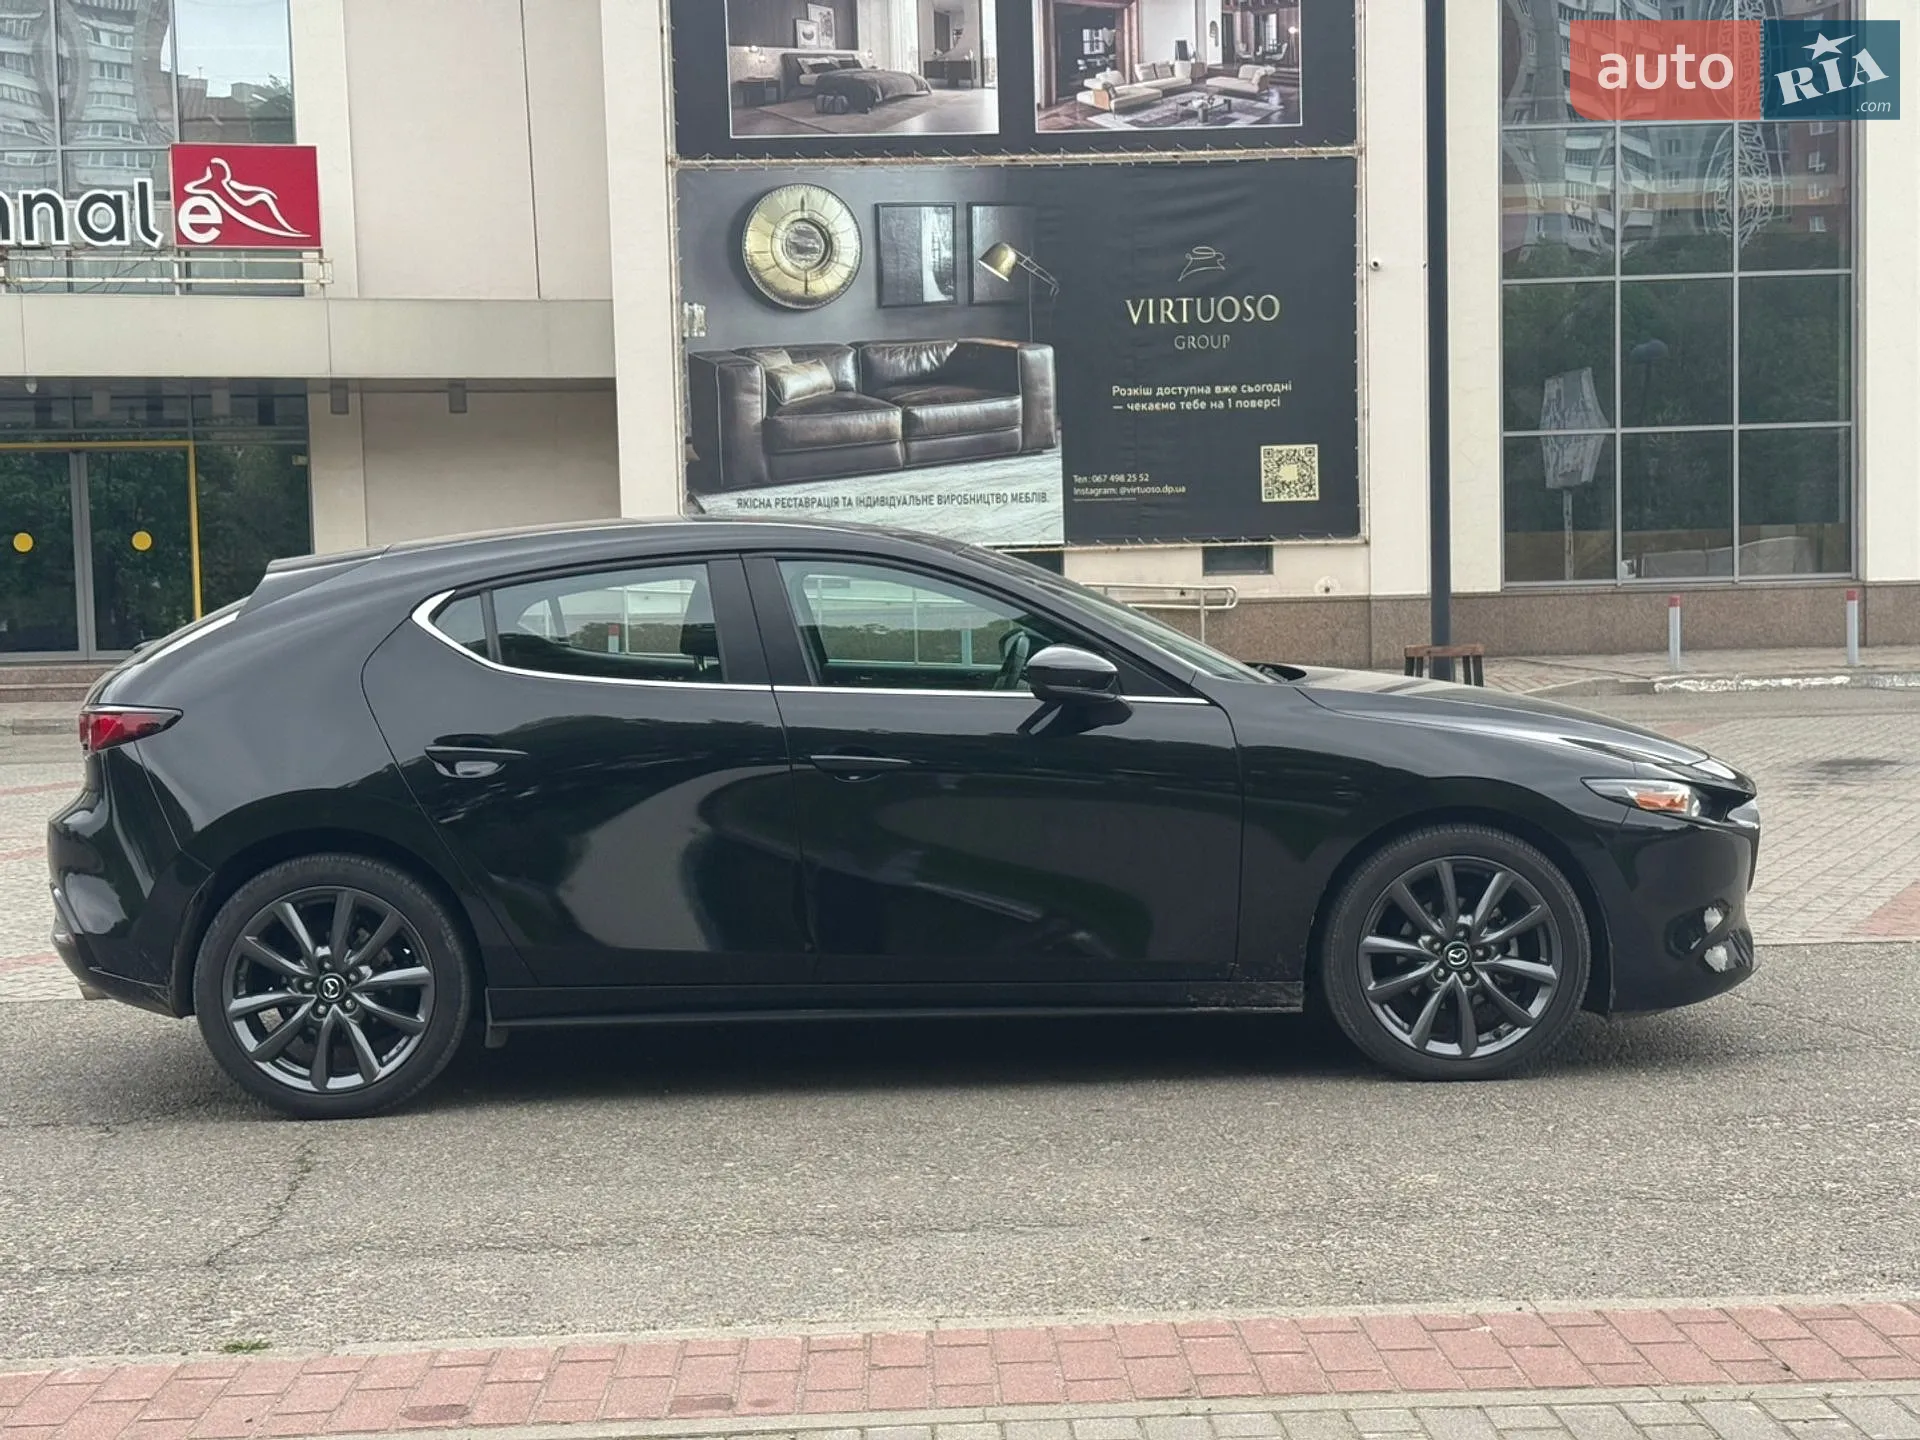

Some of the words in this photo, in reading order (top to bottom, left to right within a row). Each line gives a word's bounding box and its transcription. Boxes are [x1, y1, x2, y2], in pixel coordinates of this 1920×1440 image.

[0, 178, 164, 248] nal
[1124, 294, 1281, 325] VIRTUOSO
[1173, 334, 1231, 350] GROUP
[1111, 385, 1153, 398] Розкіш
[1155, 385, 1212, 399] доступна
[1214, 385, 1238, 395] вже
[1240, 380, 1293, 394] сьогодні
[1126, 401, 1177, 412] чекаємо
[1179, 398, 1207, 411] тебе
[1210, 401, 1225, 410] на
[1227, 398, 1233, 409] 1
[1235, 397, 1281, 410] поверсі
[1126, 473, 1138, 483] 25
[1138, 473, 1150, 482] 52
[1119, 484, 1187, 496] @virtuoso.dp.ua
[736, 497, 773, 509] ЯКІСНА
[774, 495, 841, 509] РЕСТАВРАЦІЯ
[842, 495, 852, 508] ТА
[855, 494, 935, 509] ІНДИВІДУАЛЬНЕ
[936, 491, 1009, 506] ВИРОБНИЦТВО
